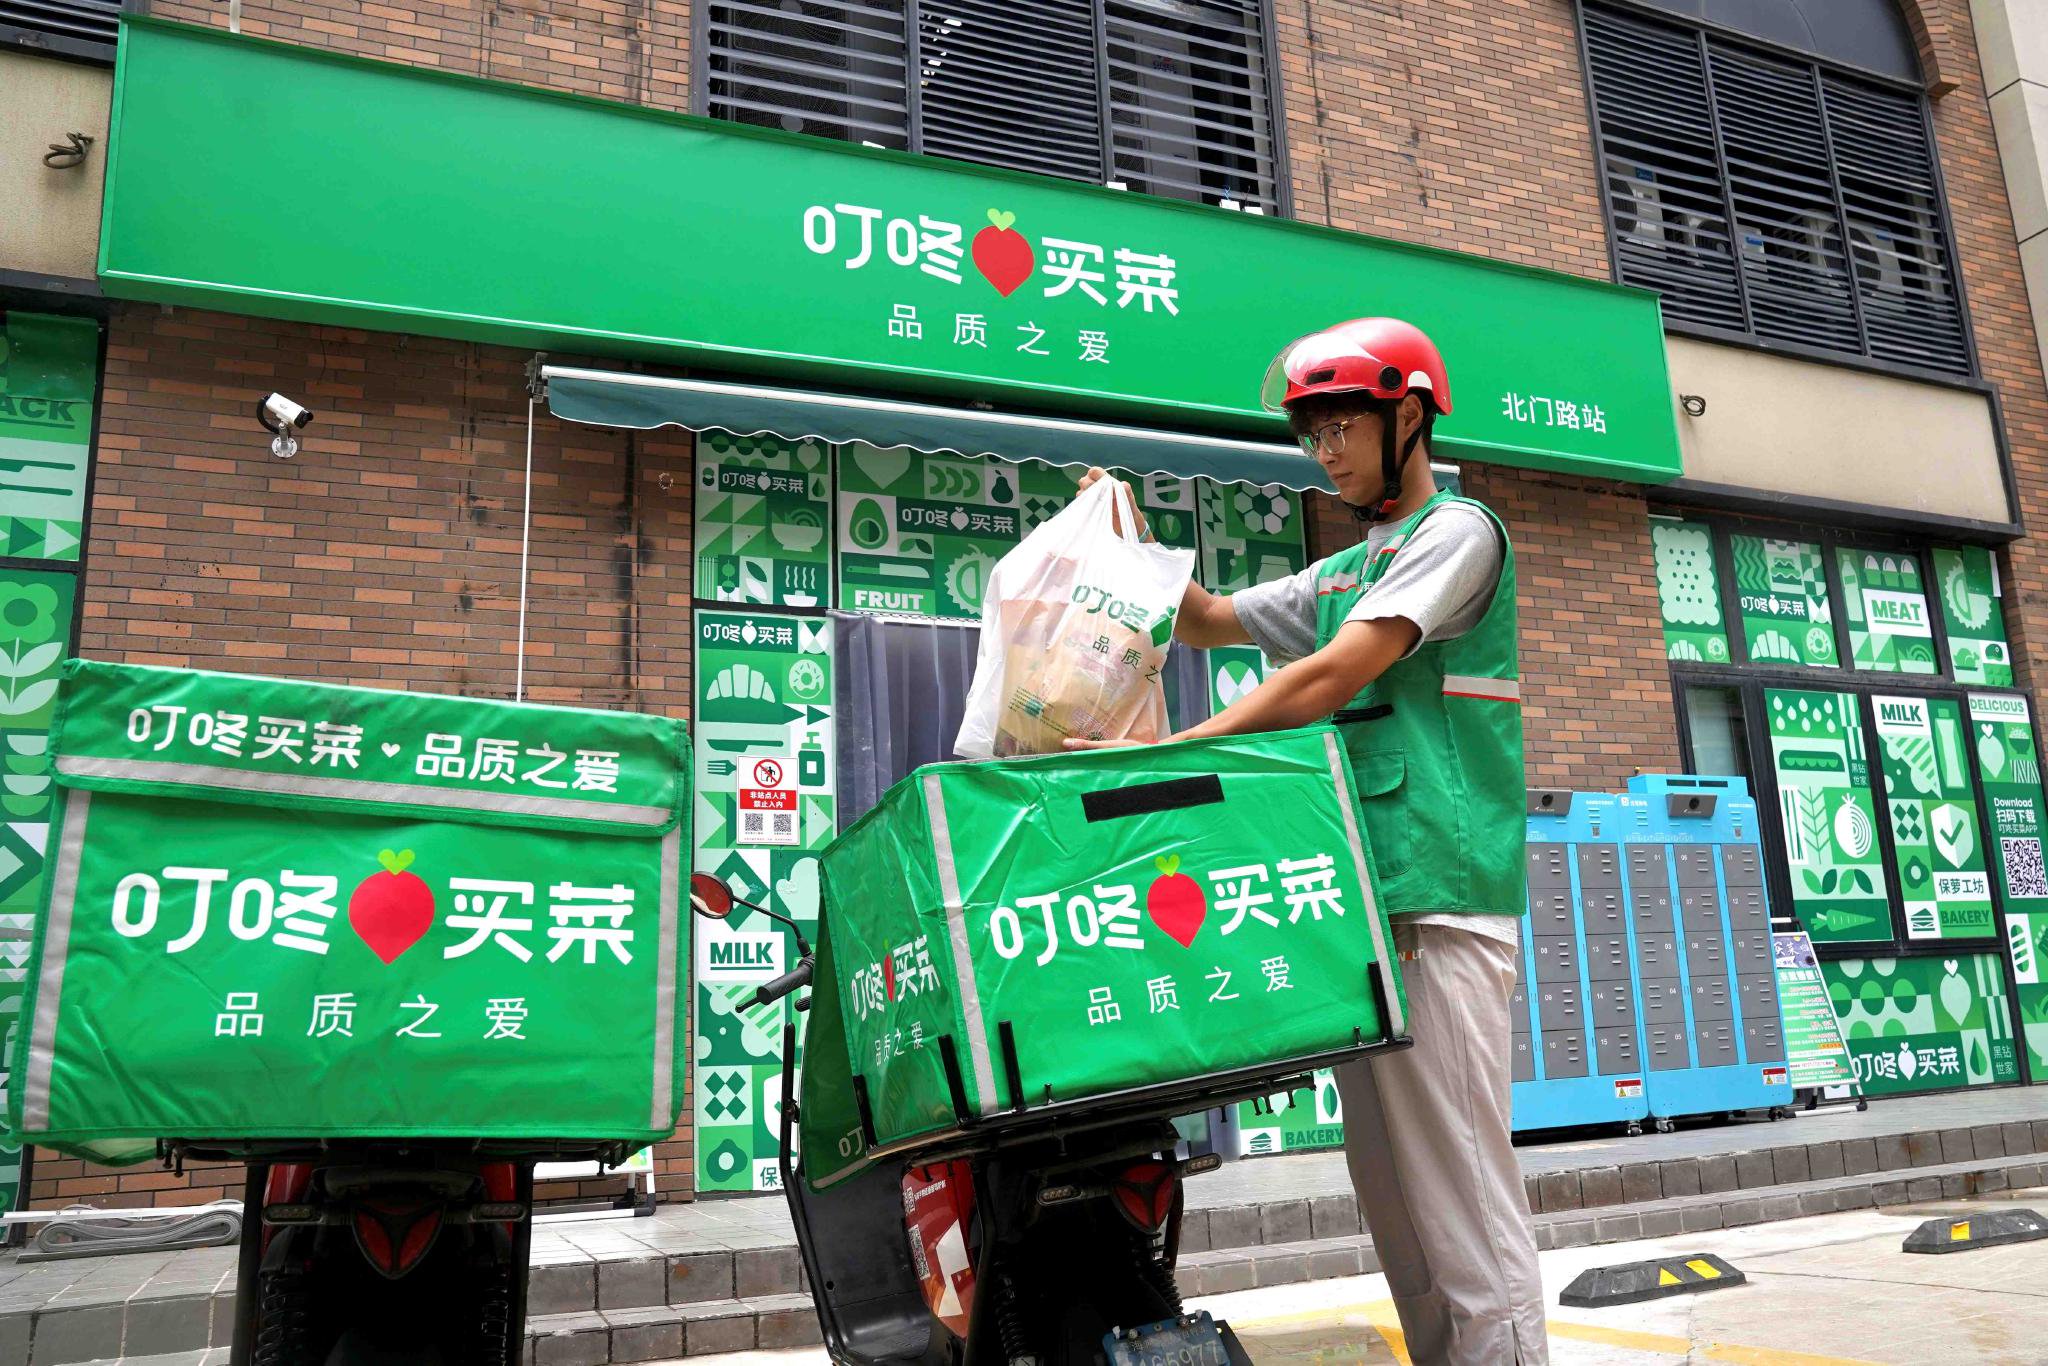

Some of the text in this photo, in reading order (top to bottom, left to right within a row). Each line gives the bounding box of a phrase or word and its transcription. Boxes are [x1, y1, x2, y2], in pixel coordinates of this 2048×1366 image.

[803, 203, 1180, 316] 叮咚买菜
[888, 303, 1110, 364] 品质之爱
[1501, 391, 1607, 434] 北门路站
[722, 472, 804, 494] 叮咚买菜
[902, 507, 1014, 534] 叮咚买菜
[854, 589, 924, 611] FRUIT
[1741, 595, 1806, 617] 叮咚买菜
[1871, 599, 1921, 622] MEAT
[703, 623, 793, 646] 叮咚买菜
[1092, 635, 1160, 684] 品质之
[1880, 703, 1923, 723] MILK
[1969, 697, 2025, 713] DELICIOUS
[127, 705, 620, 794] 叮咚买菜 品质之爱
[1993, 797, 2033, 808] Download
[1995, 808, 2036, 824] 扫码下载
[1938, 877, 1984, 895] 保萝工坊
[110, 865, 635, 966] 叮咚买菜
[990, 853, 1346, 967] 叮咚买菜
[1940, 909, 1990, 925] BAKERY
[710, 942, 774, 965] MILK
[851, 934, 941, 1023] 叮咚买菜
[1086, 955, 1294, 1026] 品质之爱
[214, 992, 529, 1040] 品质之爱
[874, 1021, 924, 1068] 品质之爱
[1852, 1046, 1961, 1082] 叮咚买菜
[1285, 1128, 1344, 1146] BAKERY
